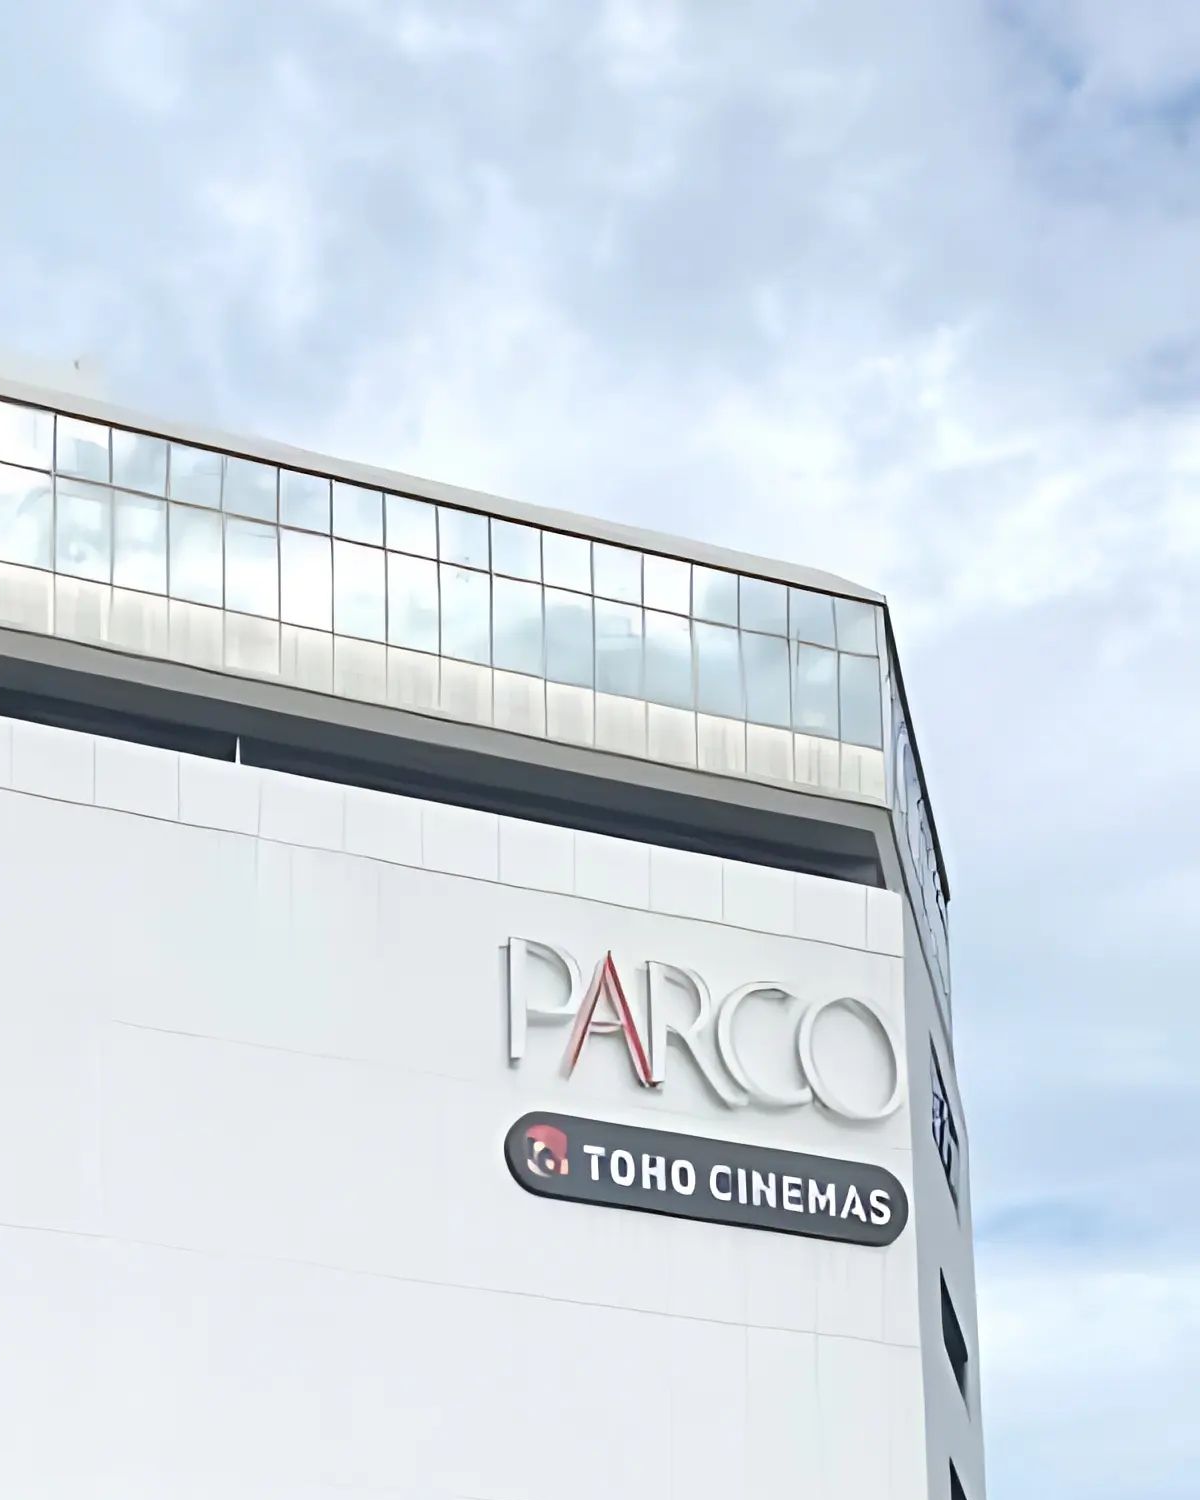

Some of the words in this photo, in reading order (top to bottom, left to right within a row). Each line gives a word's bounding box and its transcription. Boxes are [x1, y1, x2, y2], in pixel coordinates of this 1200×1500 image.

[502, 936, 901, 1120] PARCO
[583, 1144, 696, 1196] TOHO
[709, 1164, 892, 1225] CINEMAS
